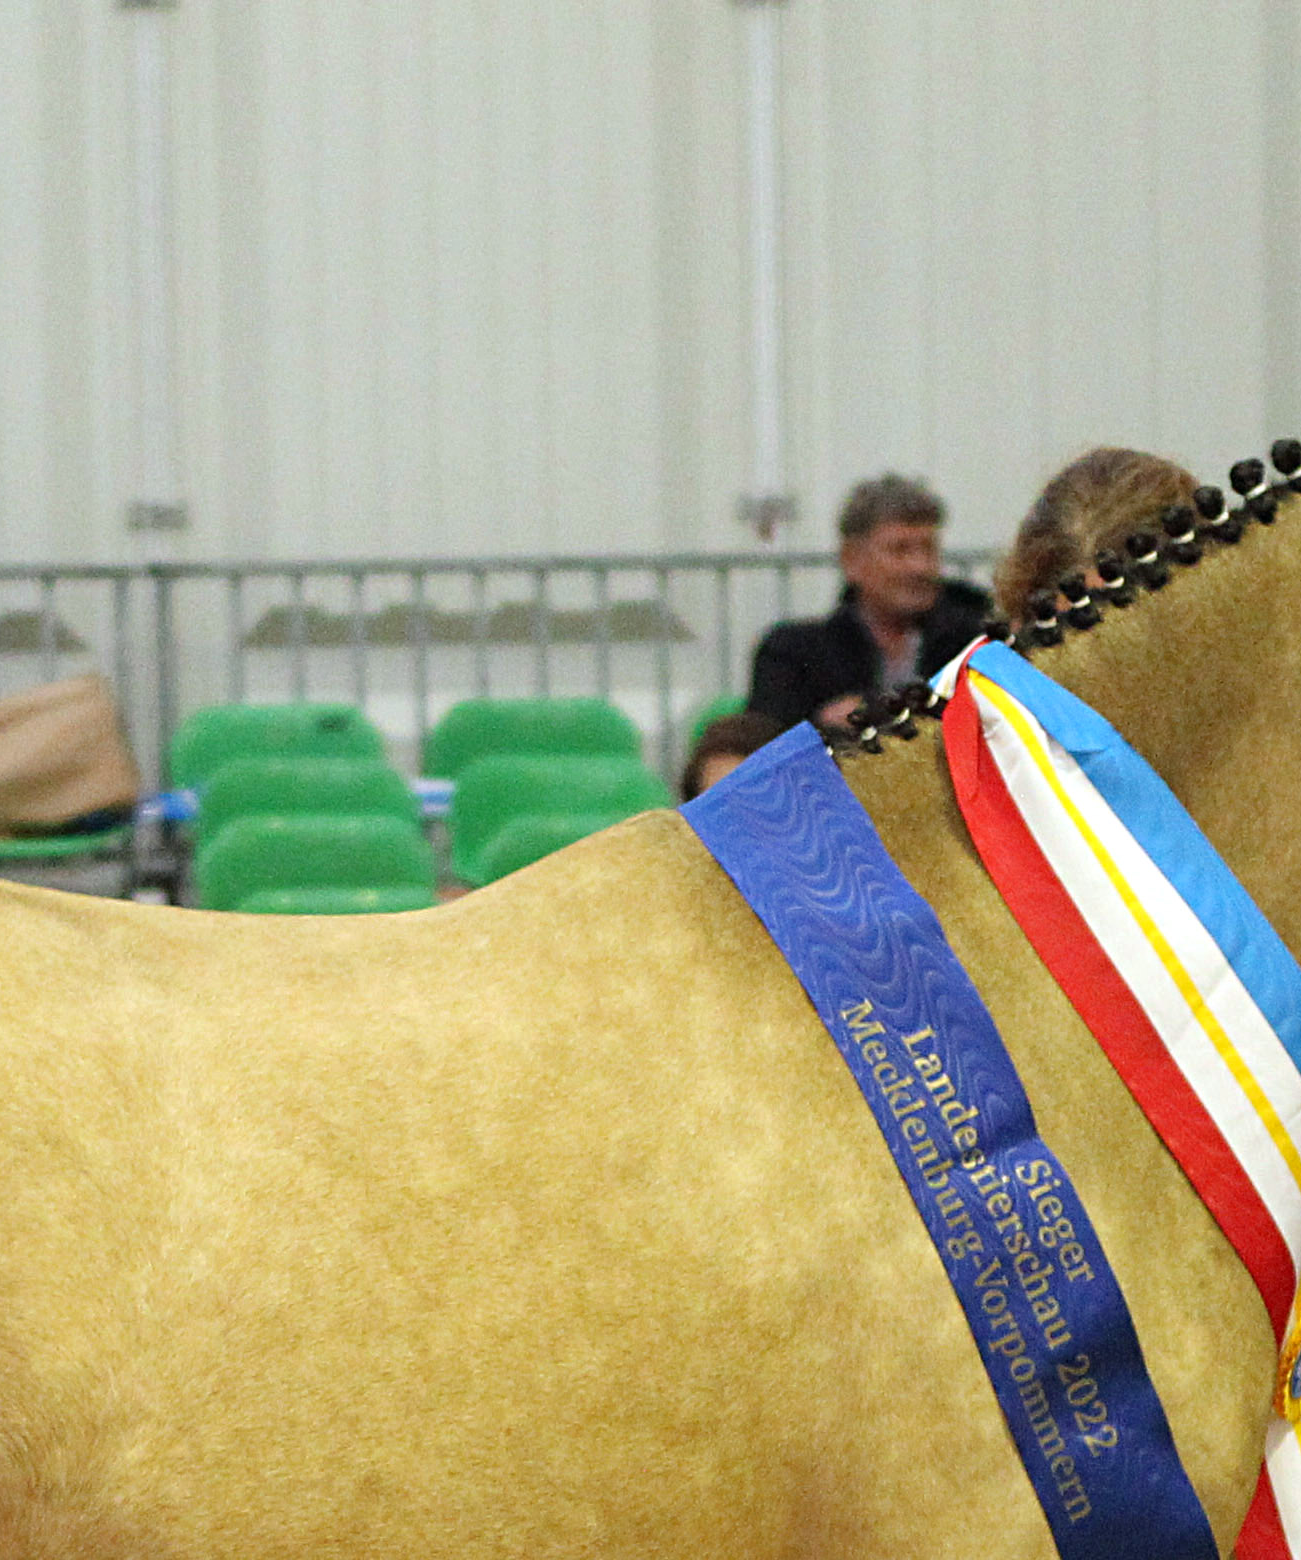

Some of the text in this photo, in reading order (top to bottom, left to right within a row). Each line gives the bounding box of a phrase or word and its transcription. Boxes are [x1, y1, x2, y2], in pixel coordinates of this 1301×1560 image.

[840, 997, 1092, 1525] Mecklenburg-Vorpommern
[900, 1025, 1118, 1457] Landestierschau 2022
[1016, 1158, 1094, 1284] Sieger
